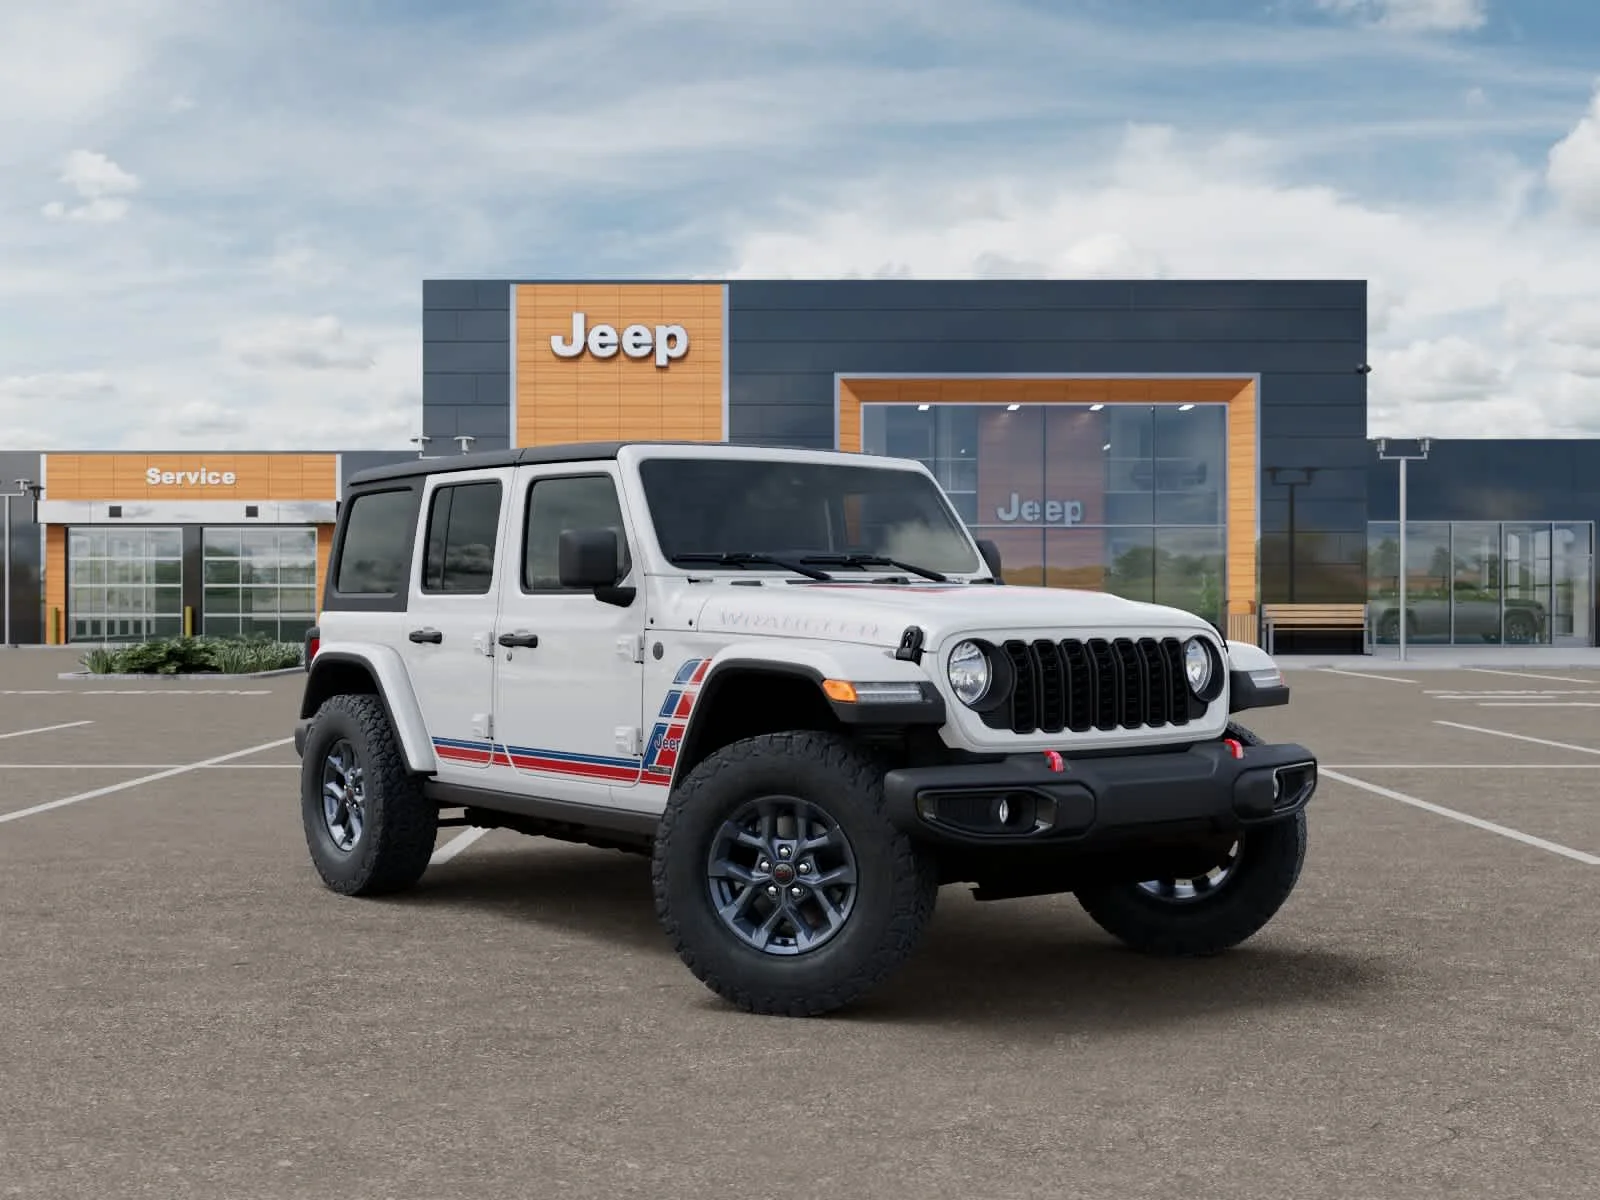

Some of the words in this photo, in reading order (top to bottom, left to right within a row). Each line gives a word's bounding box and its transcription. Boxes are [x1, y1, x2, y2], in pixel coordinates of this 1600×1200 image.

[550, 312, 689, 367] Jeep
[145, 467, 236, 486] Service
[996, 493, 1082, 527] Jeep
